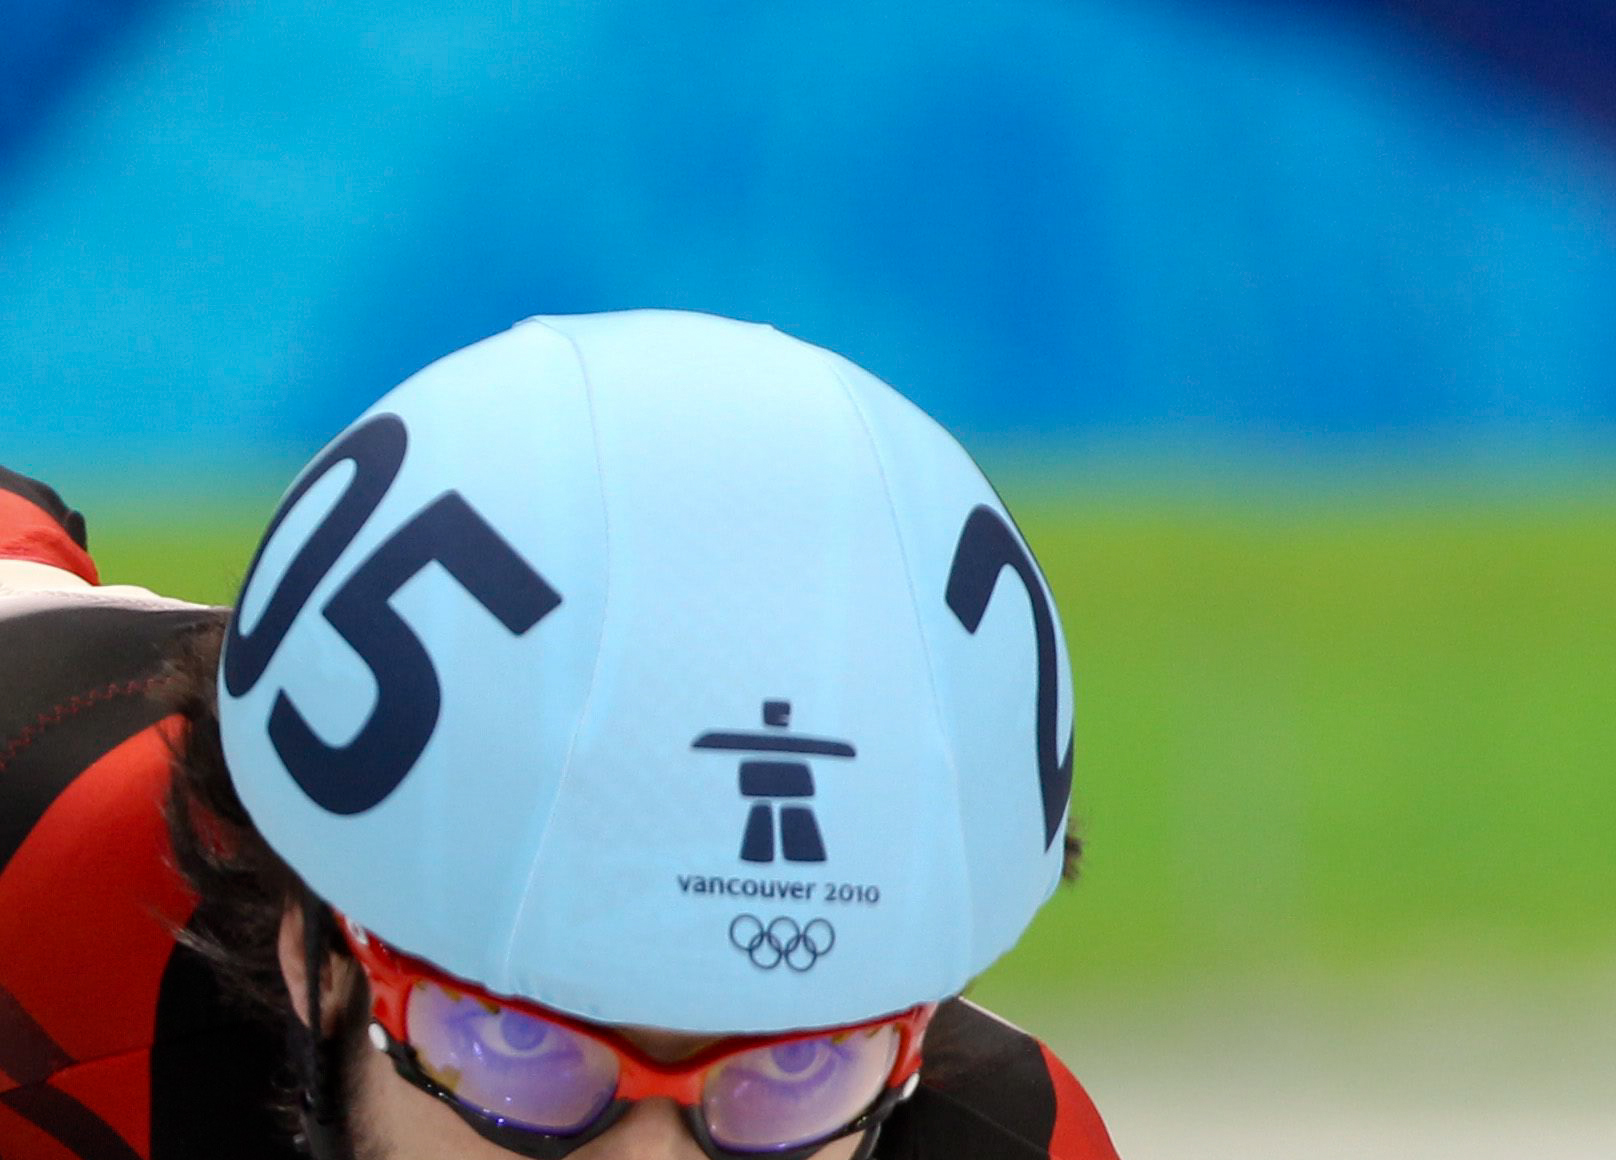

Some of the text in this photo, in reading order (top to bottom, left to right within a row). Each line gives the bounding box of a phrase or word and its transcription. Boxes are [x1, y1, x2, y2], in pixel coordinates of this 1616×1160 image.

[223, 413, 563, 815] 05
[945, 504, 1073, 855] 2
[677, 874, 881, 904] vancouver 2010
